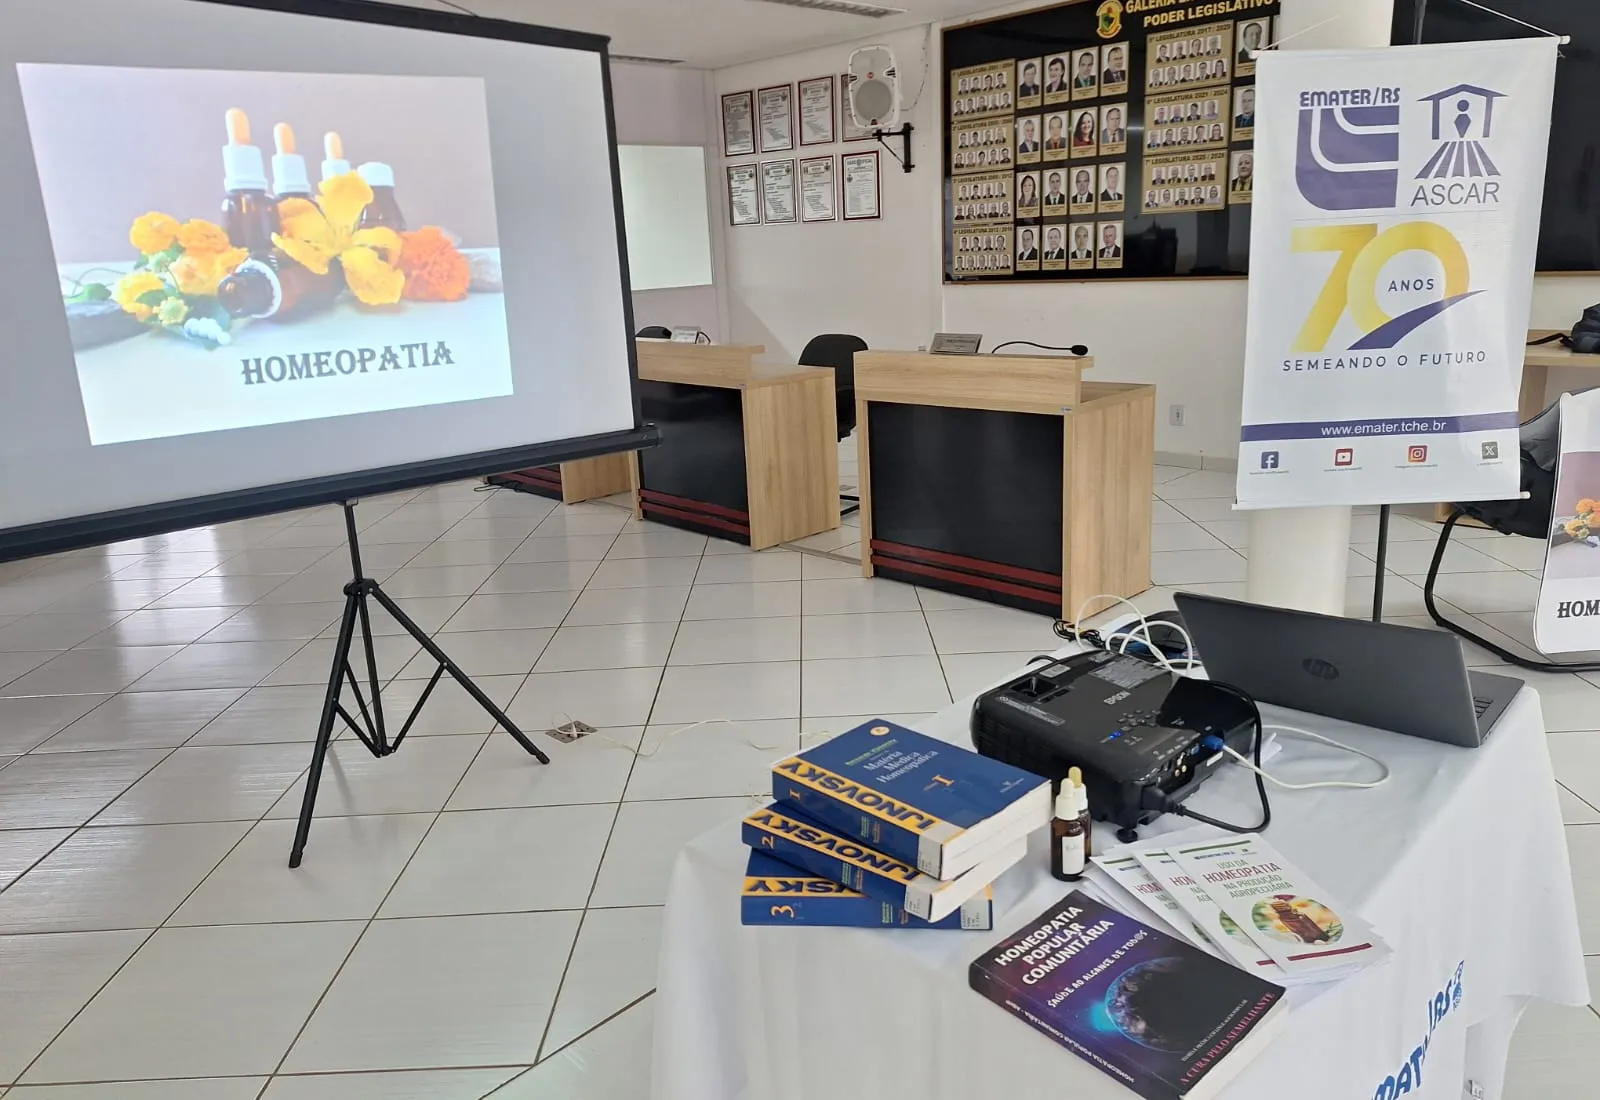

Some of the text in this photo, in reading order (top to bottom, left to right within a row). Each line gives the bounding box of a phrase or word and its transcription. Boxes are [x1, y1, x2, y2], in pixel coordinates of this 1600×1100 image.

[1143, 9, 1185, 28] PODER
[1300, 87, 1400, 106] EMATER/RS
[1410, 183, 1500, 207] ASCAR
[1290, 220, 1470, 352] 70
[1388, 278, 1434, 292] ANOS
[241, 340, 455, 385] HOMEOPATIA
[1282, 350, 1486, 372] SEMEANDO O FUTURO
[1321, 420, 1446, 436] www.emater.tche.br
[1557, 600, 1600, 618] HOM
[762, 836, 774, 848] 2
[1202, 862, 1282, 884] HOMEOPATIA
[1236, 874, 1282, 888] PRODUÇÃO
[771, 904, 795, 918] 3
[995, 906, 1084, 966] HOMEOPATIA
[1024, 922, 1086, 966] POPULAR
[1022, 920, 1114, 986] COMUNITÁRIA
[1048, 988, 1074, 1008] SAÚDE
[1072, 979, 1085, 990] AO
[1083, 959, 1115, 982] ALCANCE
[1112, 948, 1125, 961] DE
[1187, 1052, 1211, 1079] CURA
[1207, 1035, 1230, 1058] PELO
